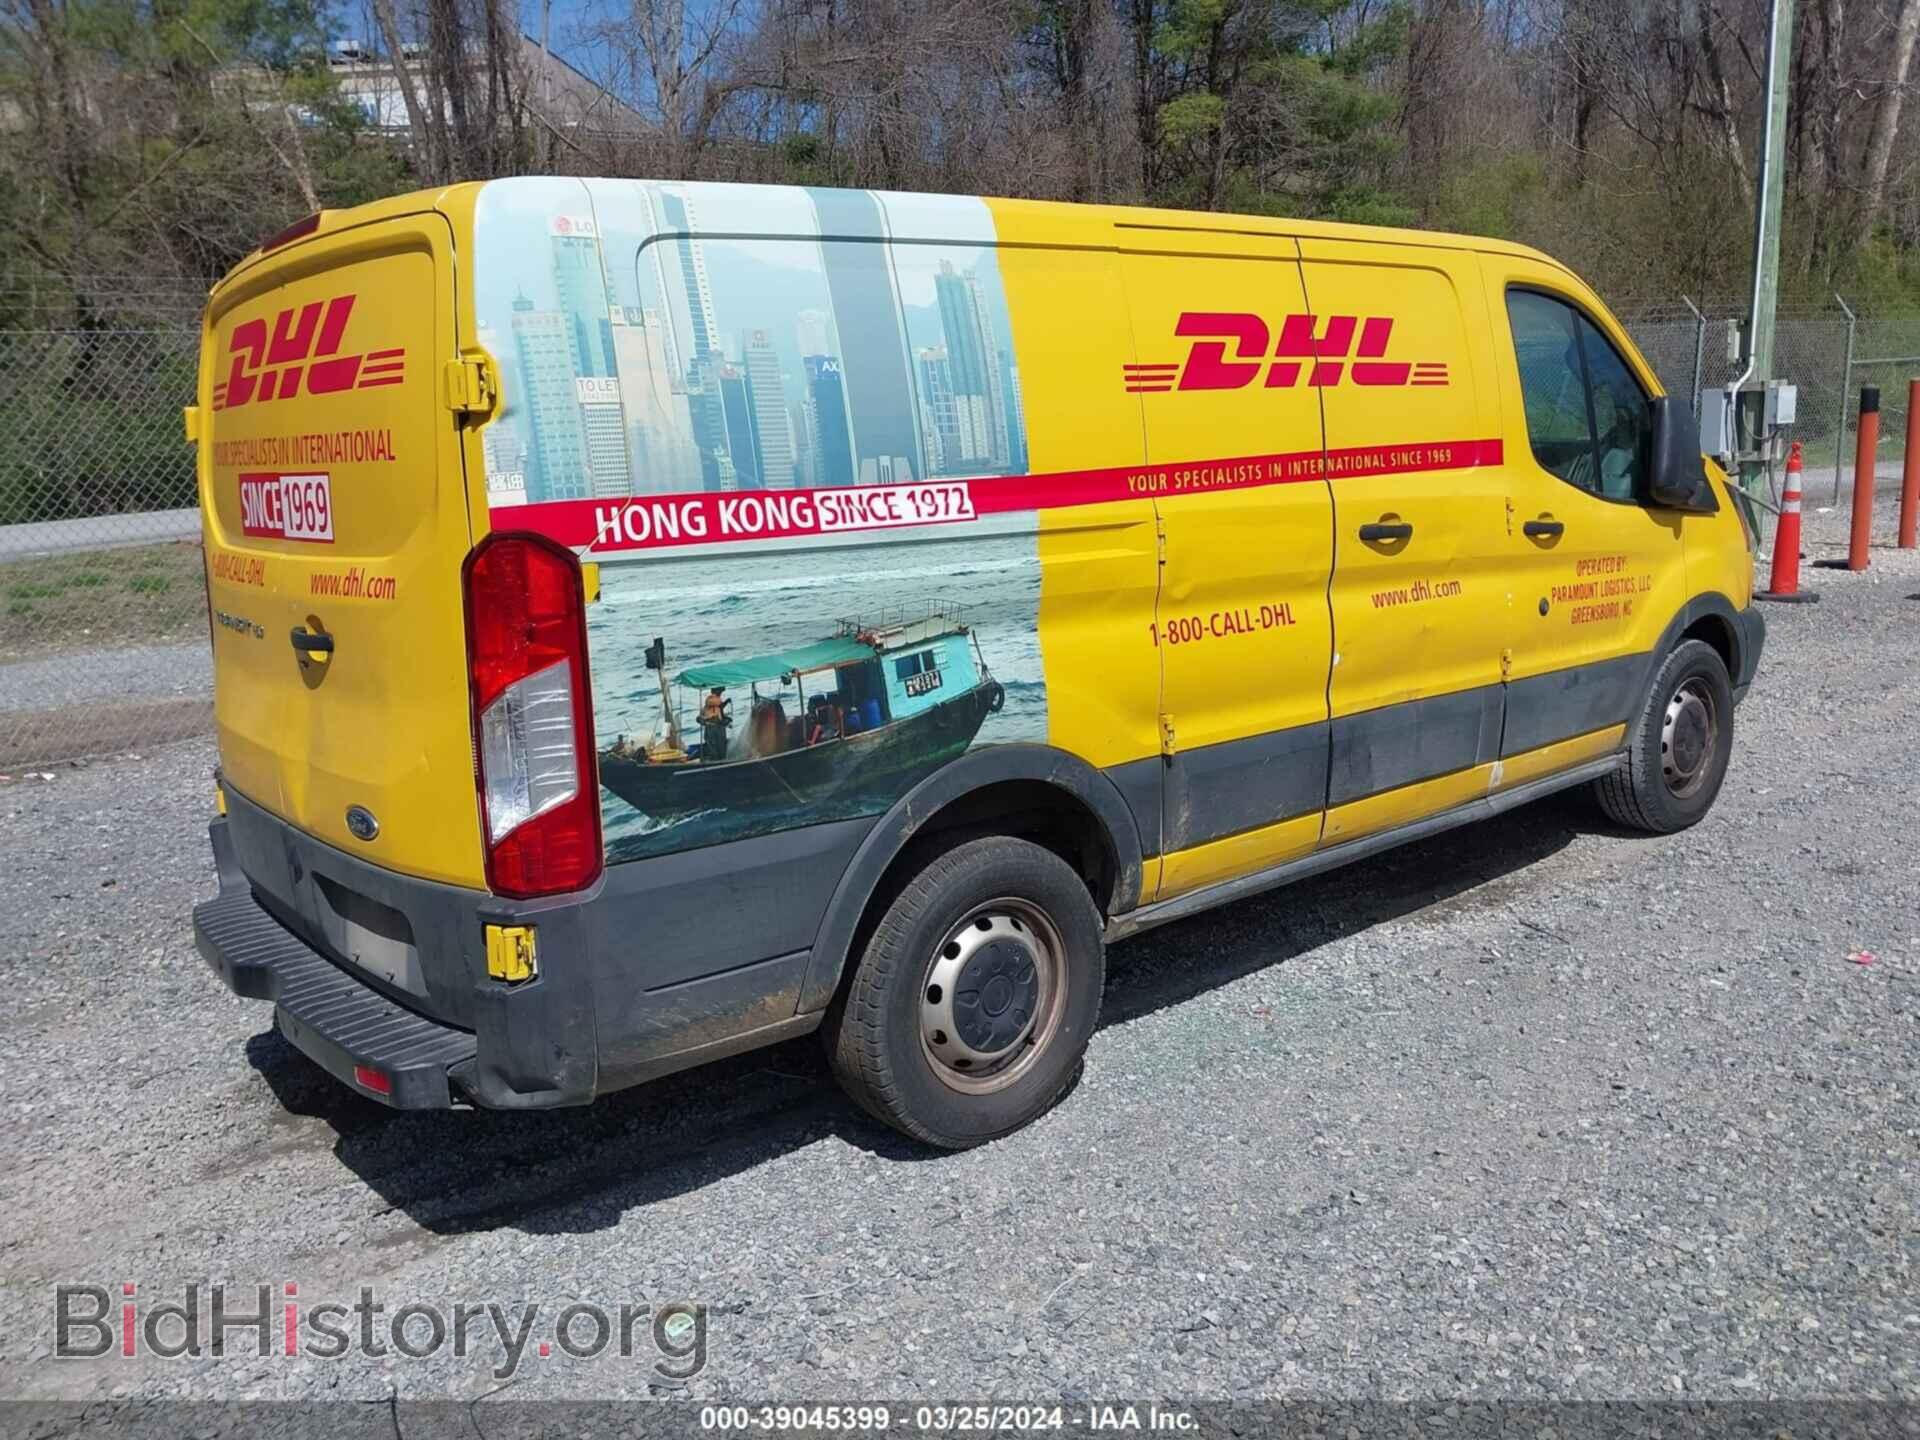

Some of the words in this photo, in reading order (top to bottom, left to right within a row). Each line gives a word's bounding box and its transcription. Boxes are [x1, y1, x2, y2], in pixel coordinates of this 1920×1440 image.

[225, 294, 363, 409] DHL
[1174, 312, 1412, 391] DHL
[579, 380, 595, 392] TO
[598, 379, 619, 392] LET
[293, 429, 396, 464] INTERNATIONAL
[1128, 473, 1167, 492] YOUR
[1175, 464, 1262, 489] SPECIALISTS
[1269, 463, 1281, 478] IN
[1288, 453, 1386, 476] INTERNATIONAL
[1391, 450, 1422, 467] SINCE
[1427, 449, 1452, 463] 1969
[240, 481, 283, 529] SINCE
[284, 482, 328, 533] 1969
[595, 501, 706, 544] HONG
[719, 496, 814, 535] KONG
[819, 491, 901, 526] SINCE
[906, 487, 970, 518] 1972
[311, 567, 396, 600] www.dhl.com
[1576, 557, 1614, 576] OPERATED
[1371, 579, 1463, 608] www.dhl.com
[1552, 582, 1598, 603] PARAMOUNT
[1639, 574, 1651, 592] LLC
[1149, 602, 1296, 647] 1-800-CALL-DHL
